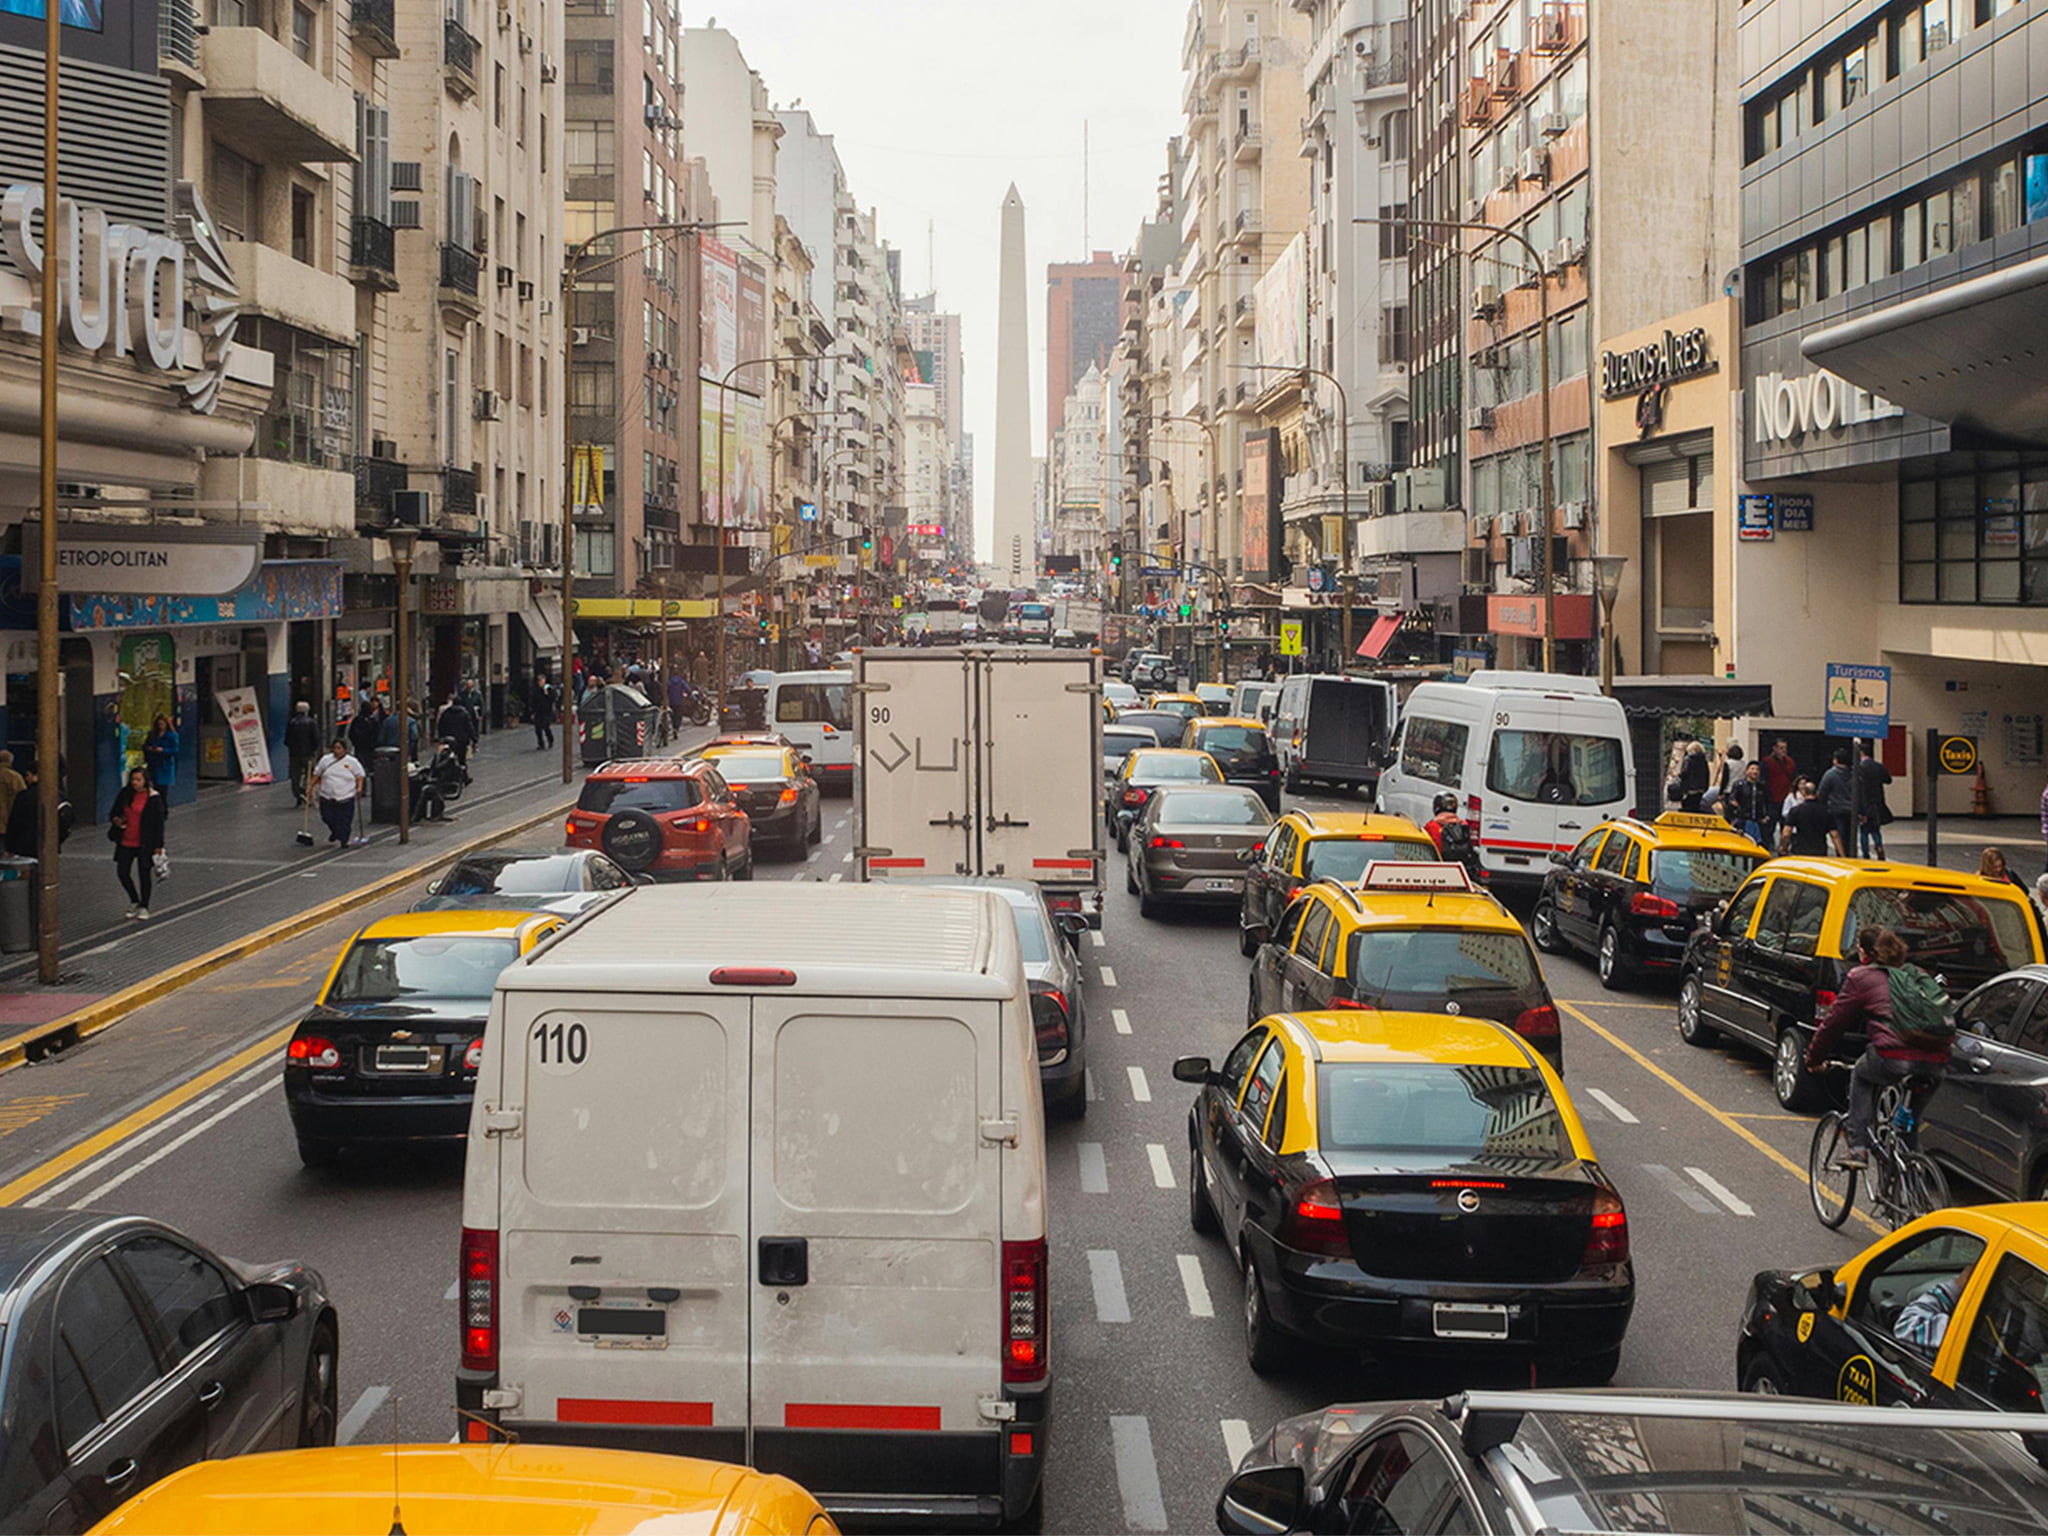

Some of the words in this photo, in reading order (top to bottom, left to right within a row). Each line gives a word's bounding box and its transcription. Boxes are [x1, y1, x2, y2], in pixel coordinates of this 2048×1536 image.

[1602, 343, 1659, 392] BUENOS
[1657, 328, 1706, 376] AIRES
[1779, 497, 1813, 508] HORA
[1745, 499, 1768, 526] E
[1784, 508, 1807, 518] DIA
[1783, 520, 1809, 529] MES
[56, 550, 168, 567] ETROPOLITAN
[1833, 664, 1885, 679] Turismo
[1832, 686, 1848, 705] A
[871, 706, 891, 724] 90
[1495, 712, 1510, 726] 90
[1944, 748, 1972, 761] Taxis
[533, 1022, 588, 1065] 110
[1849, 1366, 1870, 1390] TAXI
